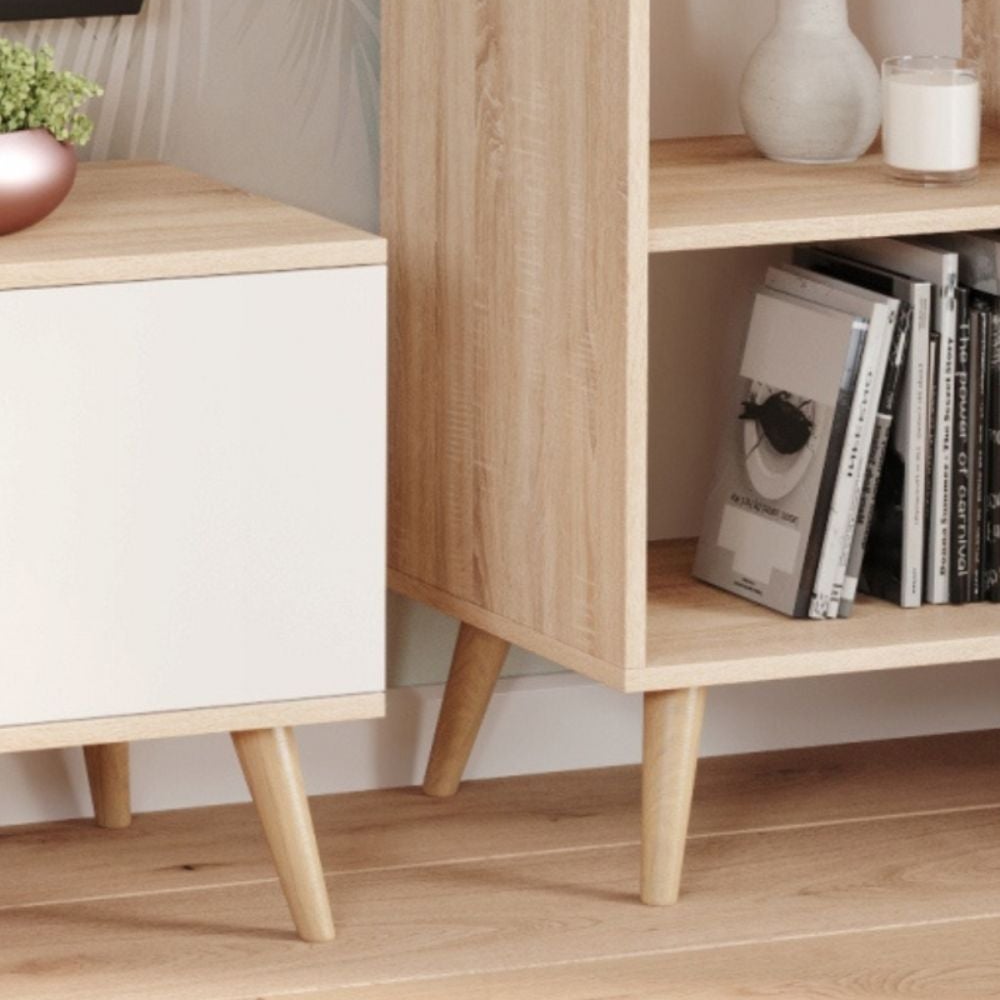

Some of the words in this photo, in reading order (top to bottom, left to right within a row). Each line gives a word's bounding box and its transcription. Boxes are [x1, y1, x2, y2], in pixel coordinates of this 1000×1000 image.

[959, 324, 969, 363] The
[954, 371, 968, 438] power
[958, 452, 968, 475] of
[941, 465, 949, 525] Summer
[957, 485, 968, 576] carnival
